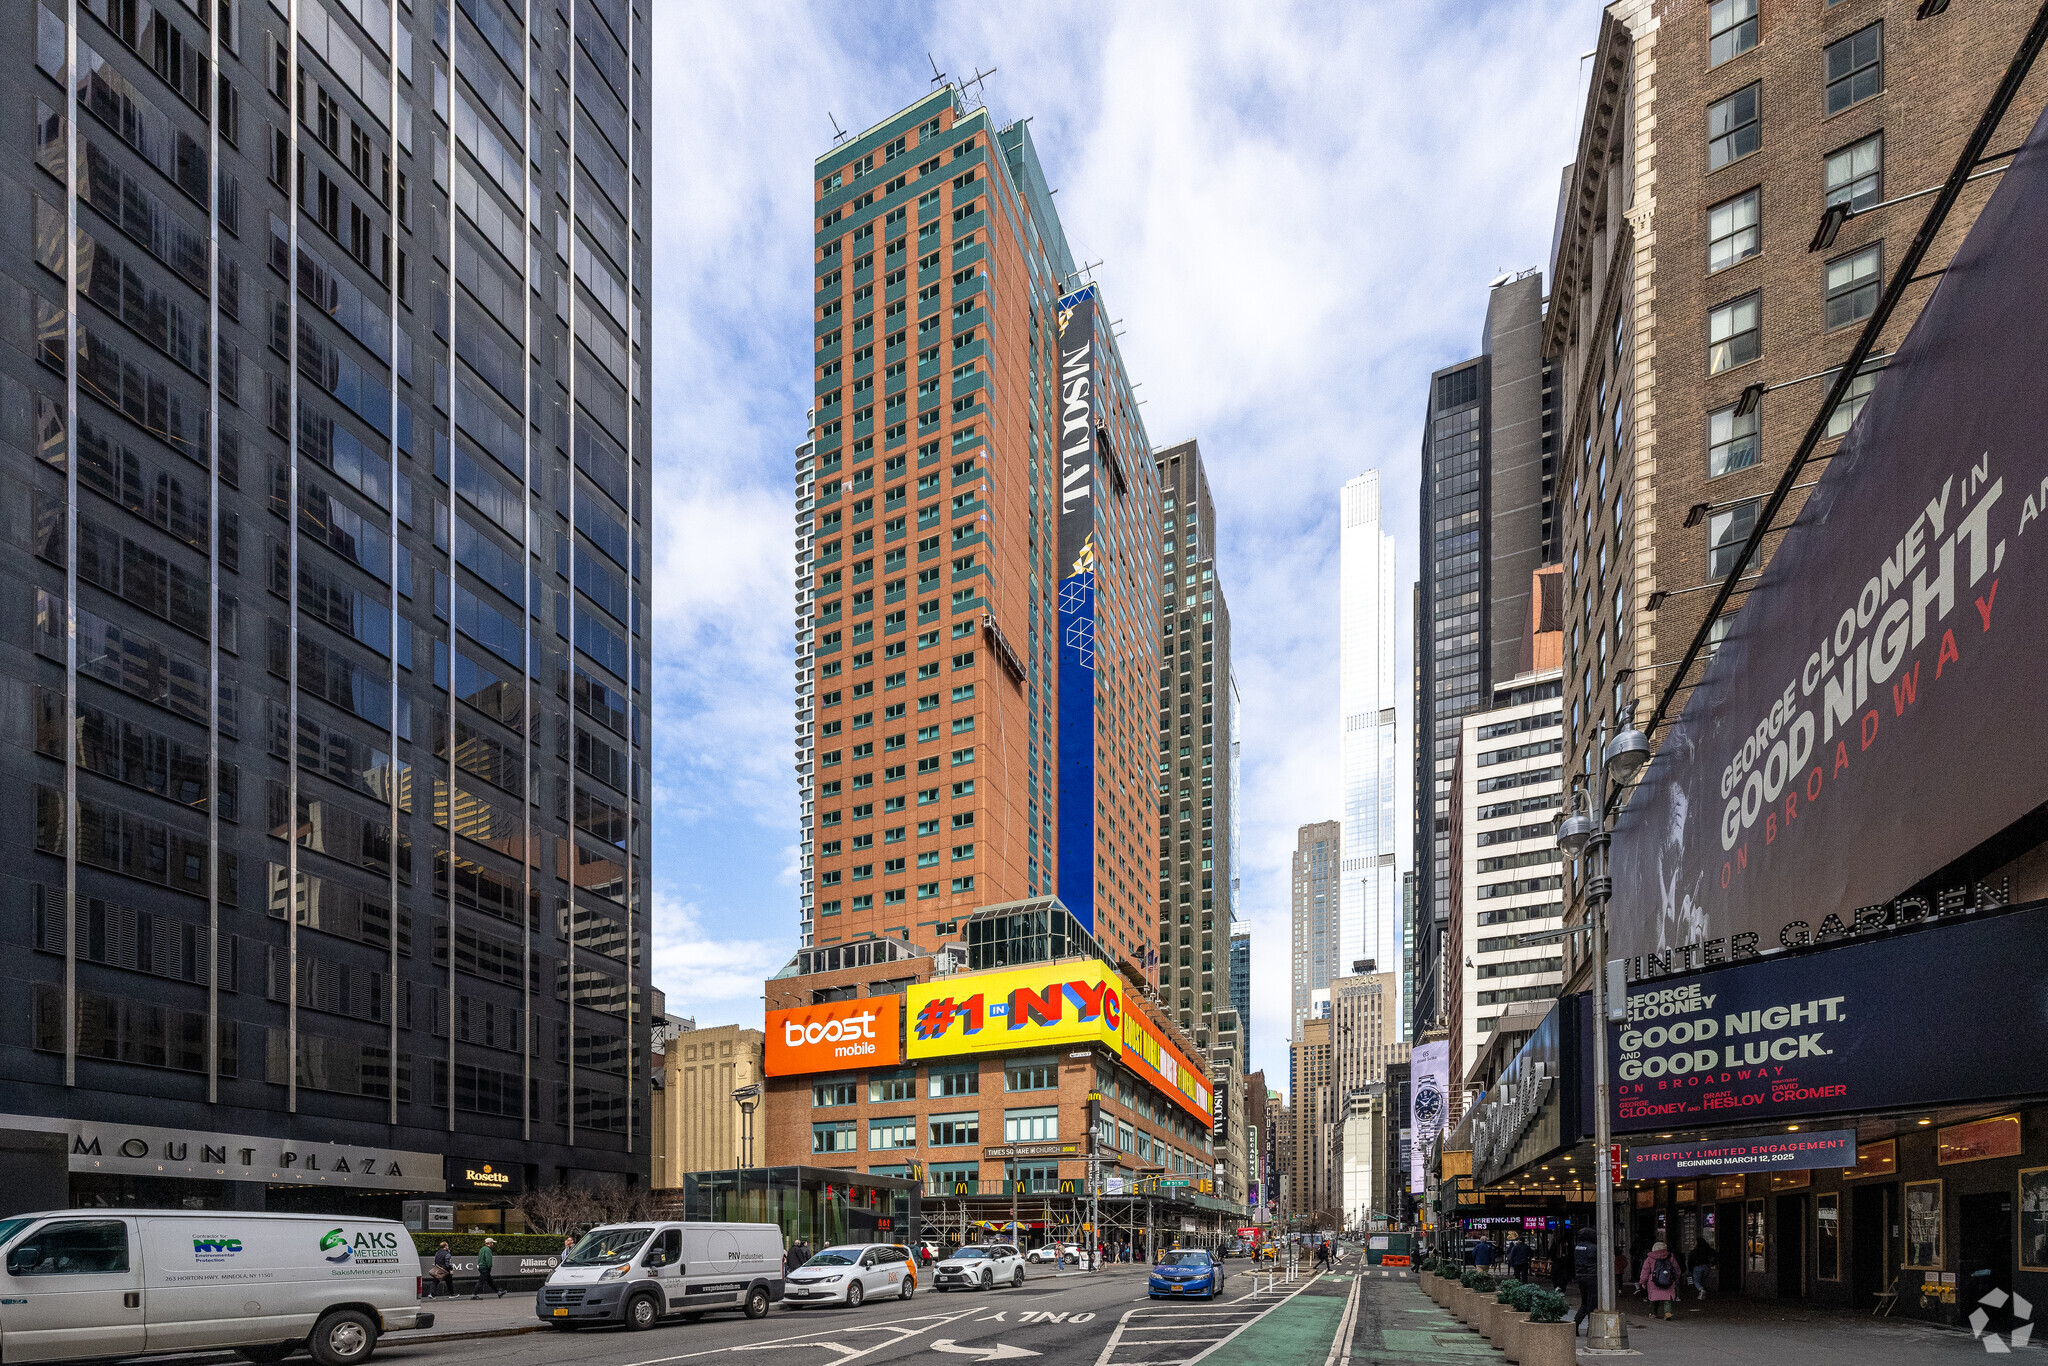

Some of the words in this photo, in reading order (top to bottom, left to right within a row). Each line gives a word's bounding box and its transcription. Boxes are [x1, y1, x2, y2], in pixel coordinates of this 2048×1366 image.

[1721, 678, 1797, 800] GEORGE
[1802, 474, 1953, 696] CLOONEY
[1961, 451, 1988, 508] IN
[1721, 710, 1815, 852] GOOD
[1824, 476, 2006, 744] NIGHT,
[1721, 843, 1747, 889] ON
[1766, 578, 1999, 845] BROADWAY
[1606, 932, 1762, 982] INTER
[1780, 874, 2010, 948] GARDEN
[1351, 976, 1375, 986] 1740
[1626, 983, 1701, 1009] GEORGE
[914, 992, 984, 1041] #1
[992, 1006, 1005, 1015] IN
[1007, 979, 1120, 1032] NYC
[785, 1011, 876, 1047] boost
[1619, 1018, 1719, 1052] GOOD
[1725, 996, 1846, 1037] NIGHT,
[1619, 1023, 1631, 1032] IN
[835, 1041, 876, 1058] mobile
[1619, 1051, 1641, 1061] AND
[1619, 1049, 1719, 1081] GOOD
[1725, 1032, 1833, 1068] LUCK.
[1619, 1083, 1644, 1095] ON
[1658, 1065, 1784, 1090] BROADWAY
[1772, 1083, 1798, 1092] DAVID
[1619, 1102, 1687, 1119] CLOONEY
[1687, 1105, 1701, 1113] AND
[1703, 1093, 1765, 1110] HESLOV
[1772, 1084, 1847, 1103] CROMER
[1703, 1090, 1731, 1100] GRANT
[1619, 1100, 1649, 1109] GEORGE
[72, 1133, 256, 1166] MOUNT
[280, 1151, 403, 1177] PLAZA
[1036, 1146, 1060, 1154] CHURCH
[1636, 1151, 1692, 1162] STRICTLY
[1697, 1147, 1746, 1158] LIMITED
[1751, 1139, 1846, 1154] ENGAGEMENT
[1677, 1157, 1723, 1168] BEGINNING
[1724, 1155, 1758, 1166] MARCH
[1758, 1154, 1771, 1164] 12,
[1771, 1153, 1795, 1162] 2025
[465, 1170, 510, 1183] Rosetta
[1482, 1216, 1521, 1224] REYNOLDS
[193, 1239, 243, 1253] NYC
[354, 1249, 398, 1258] METERING
[728, 1252, 740, 1260] PNV
[520, 1258, 548, 1267] Allianz
[331, 1268, 401, 1276] SaksMetering.com
[974, 1311, 1097, 1324] ONLY
